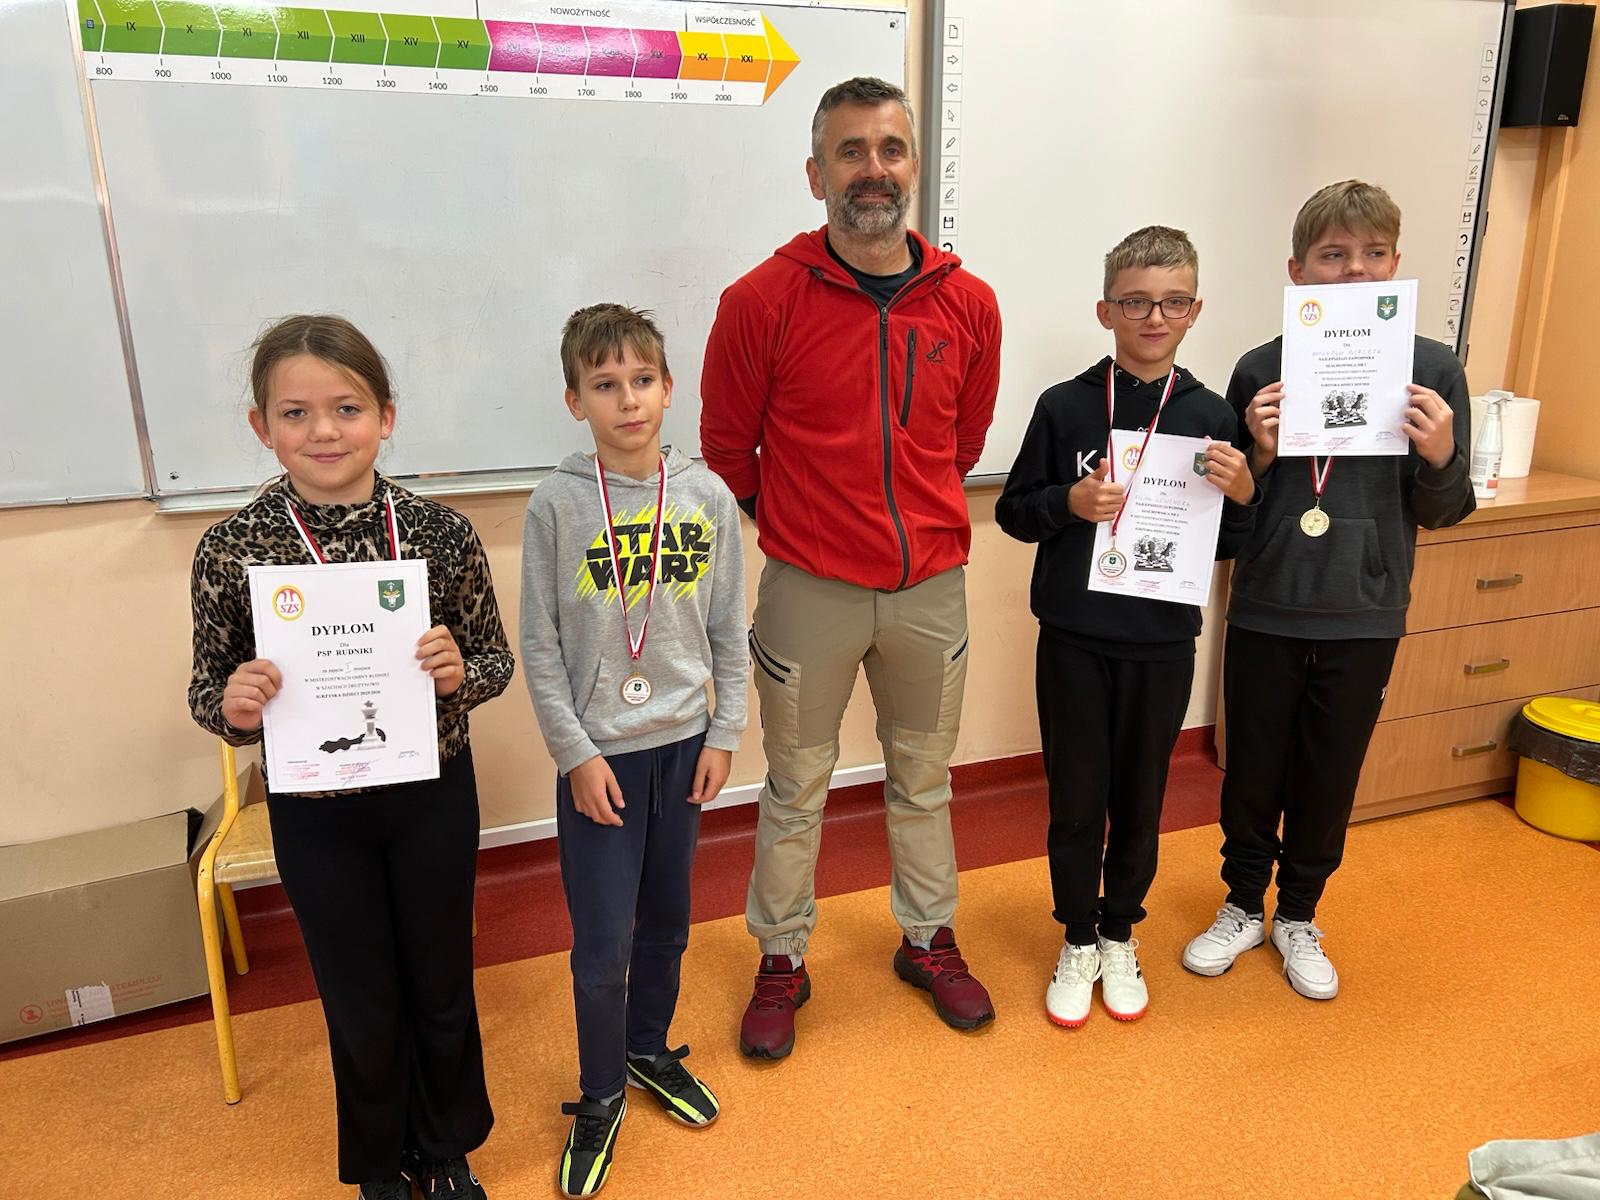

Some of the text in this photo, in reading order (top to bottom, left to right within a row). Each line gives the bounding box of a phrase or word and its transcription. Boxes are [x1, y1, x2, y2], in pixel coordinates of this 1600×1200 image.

[550, 7, 611, 18] NOWOŻYTNOŚĆ
[694, 15, 756, 27] WSPÓŁCZESNOŚĆ
[126, 21, 137, 31] IX
[186, 24, 194, 34] X
[242, 27, 252, 37] XI
[296, 30, 310, 40] XII
[350, 33, 366, 43] XIII
[403, 36, 419, 46] XIV
[457, 39, 469, 49] XV
[697, 52, 708, 61] XX
[740, 54, 753, 63] XXI
[95, 67, 732, 102] 800 900 1000 1100 1200 1300 1400 1500 1600 1700 1800 1900 2000
[1324, 328, 1371, 338] DYPLOM
[1143, 476, 1187, 489] DYPLOM
[586, 522, 711, 560] STAR
[587, 552, 710, 591] WARS
[280, 603, 299, 614] SZS
[311, 622, 375, 637] DYPLOM
[335, 647, 373, 656] RUDNIKI
